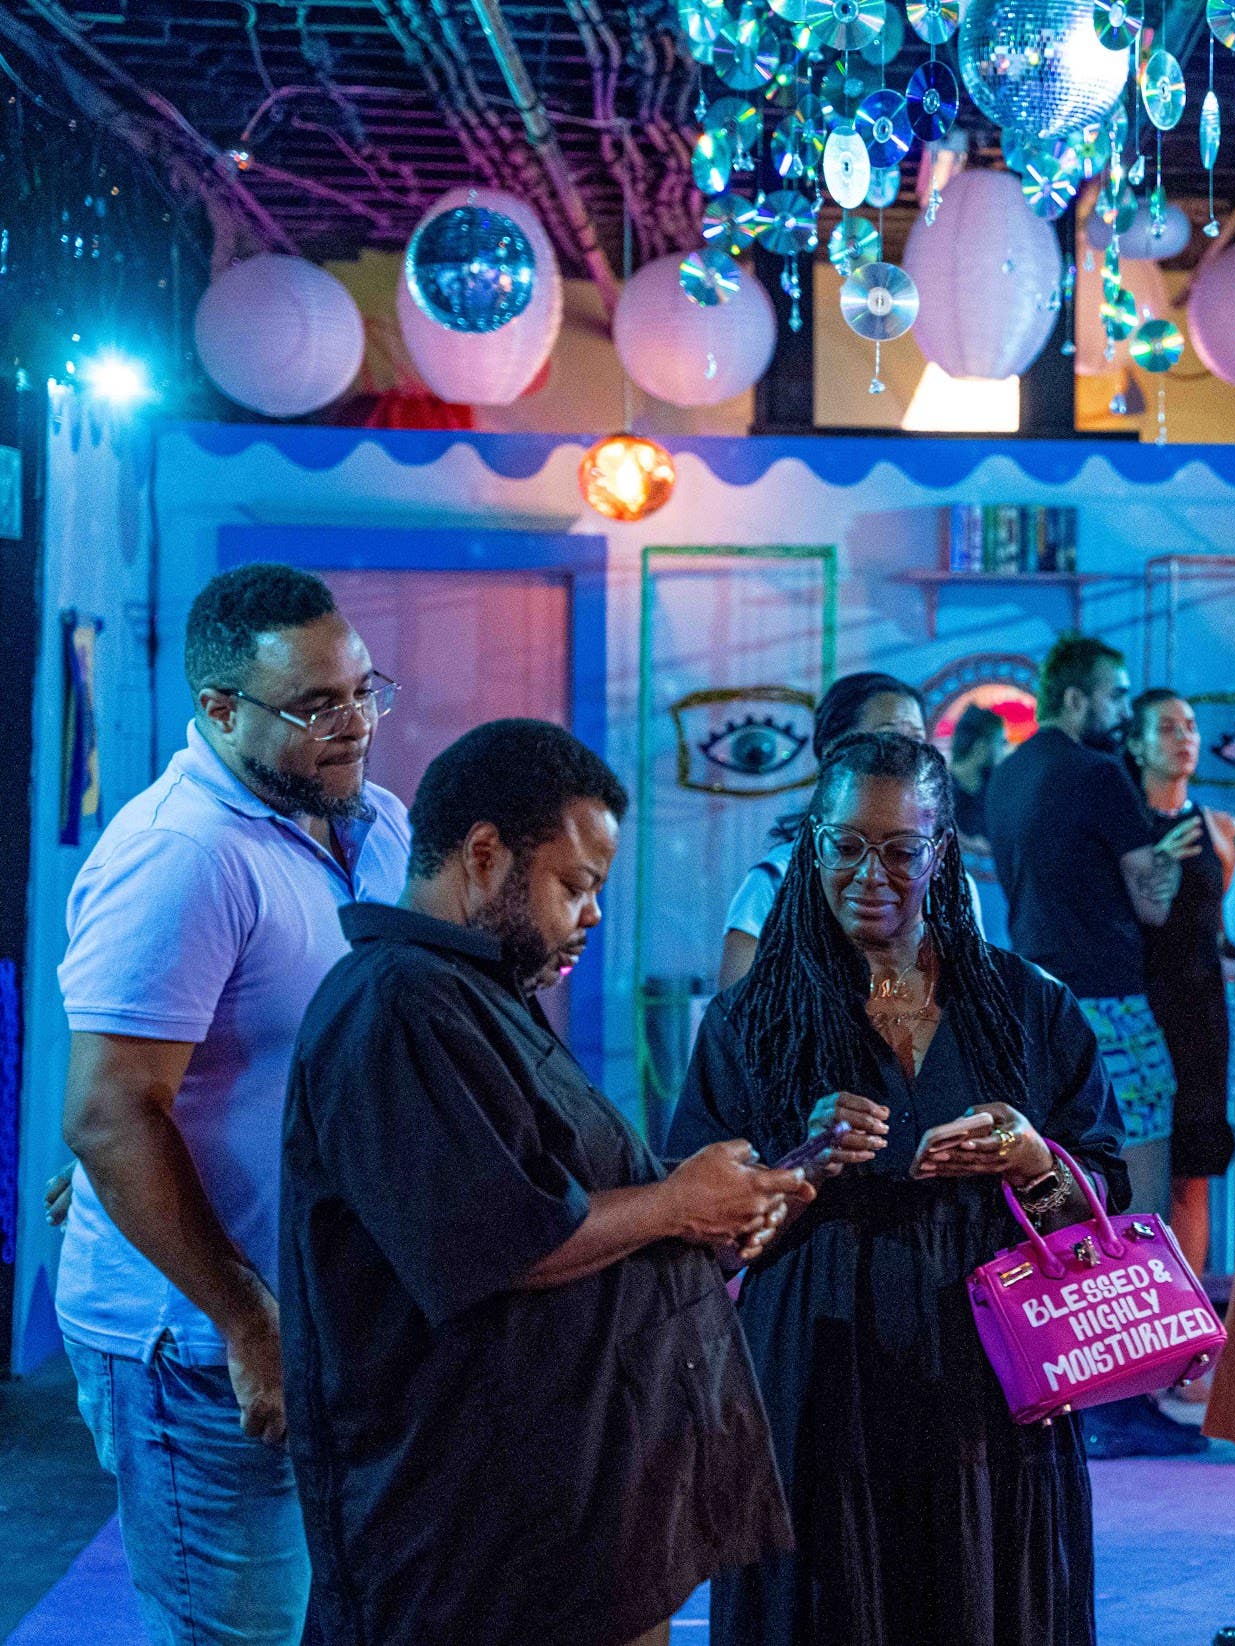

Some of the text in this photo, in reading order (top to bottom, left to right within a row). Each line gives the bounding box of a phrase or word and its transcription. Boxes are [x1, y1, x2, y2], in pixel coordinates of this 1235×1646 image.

[1022, 1264, 1149, 1328] BLESSED
[1069, 1288, 1160, 1341] HIGHLY
[1043, 1308, 1217, 1391] MOISTURIZED
